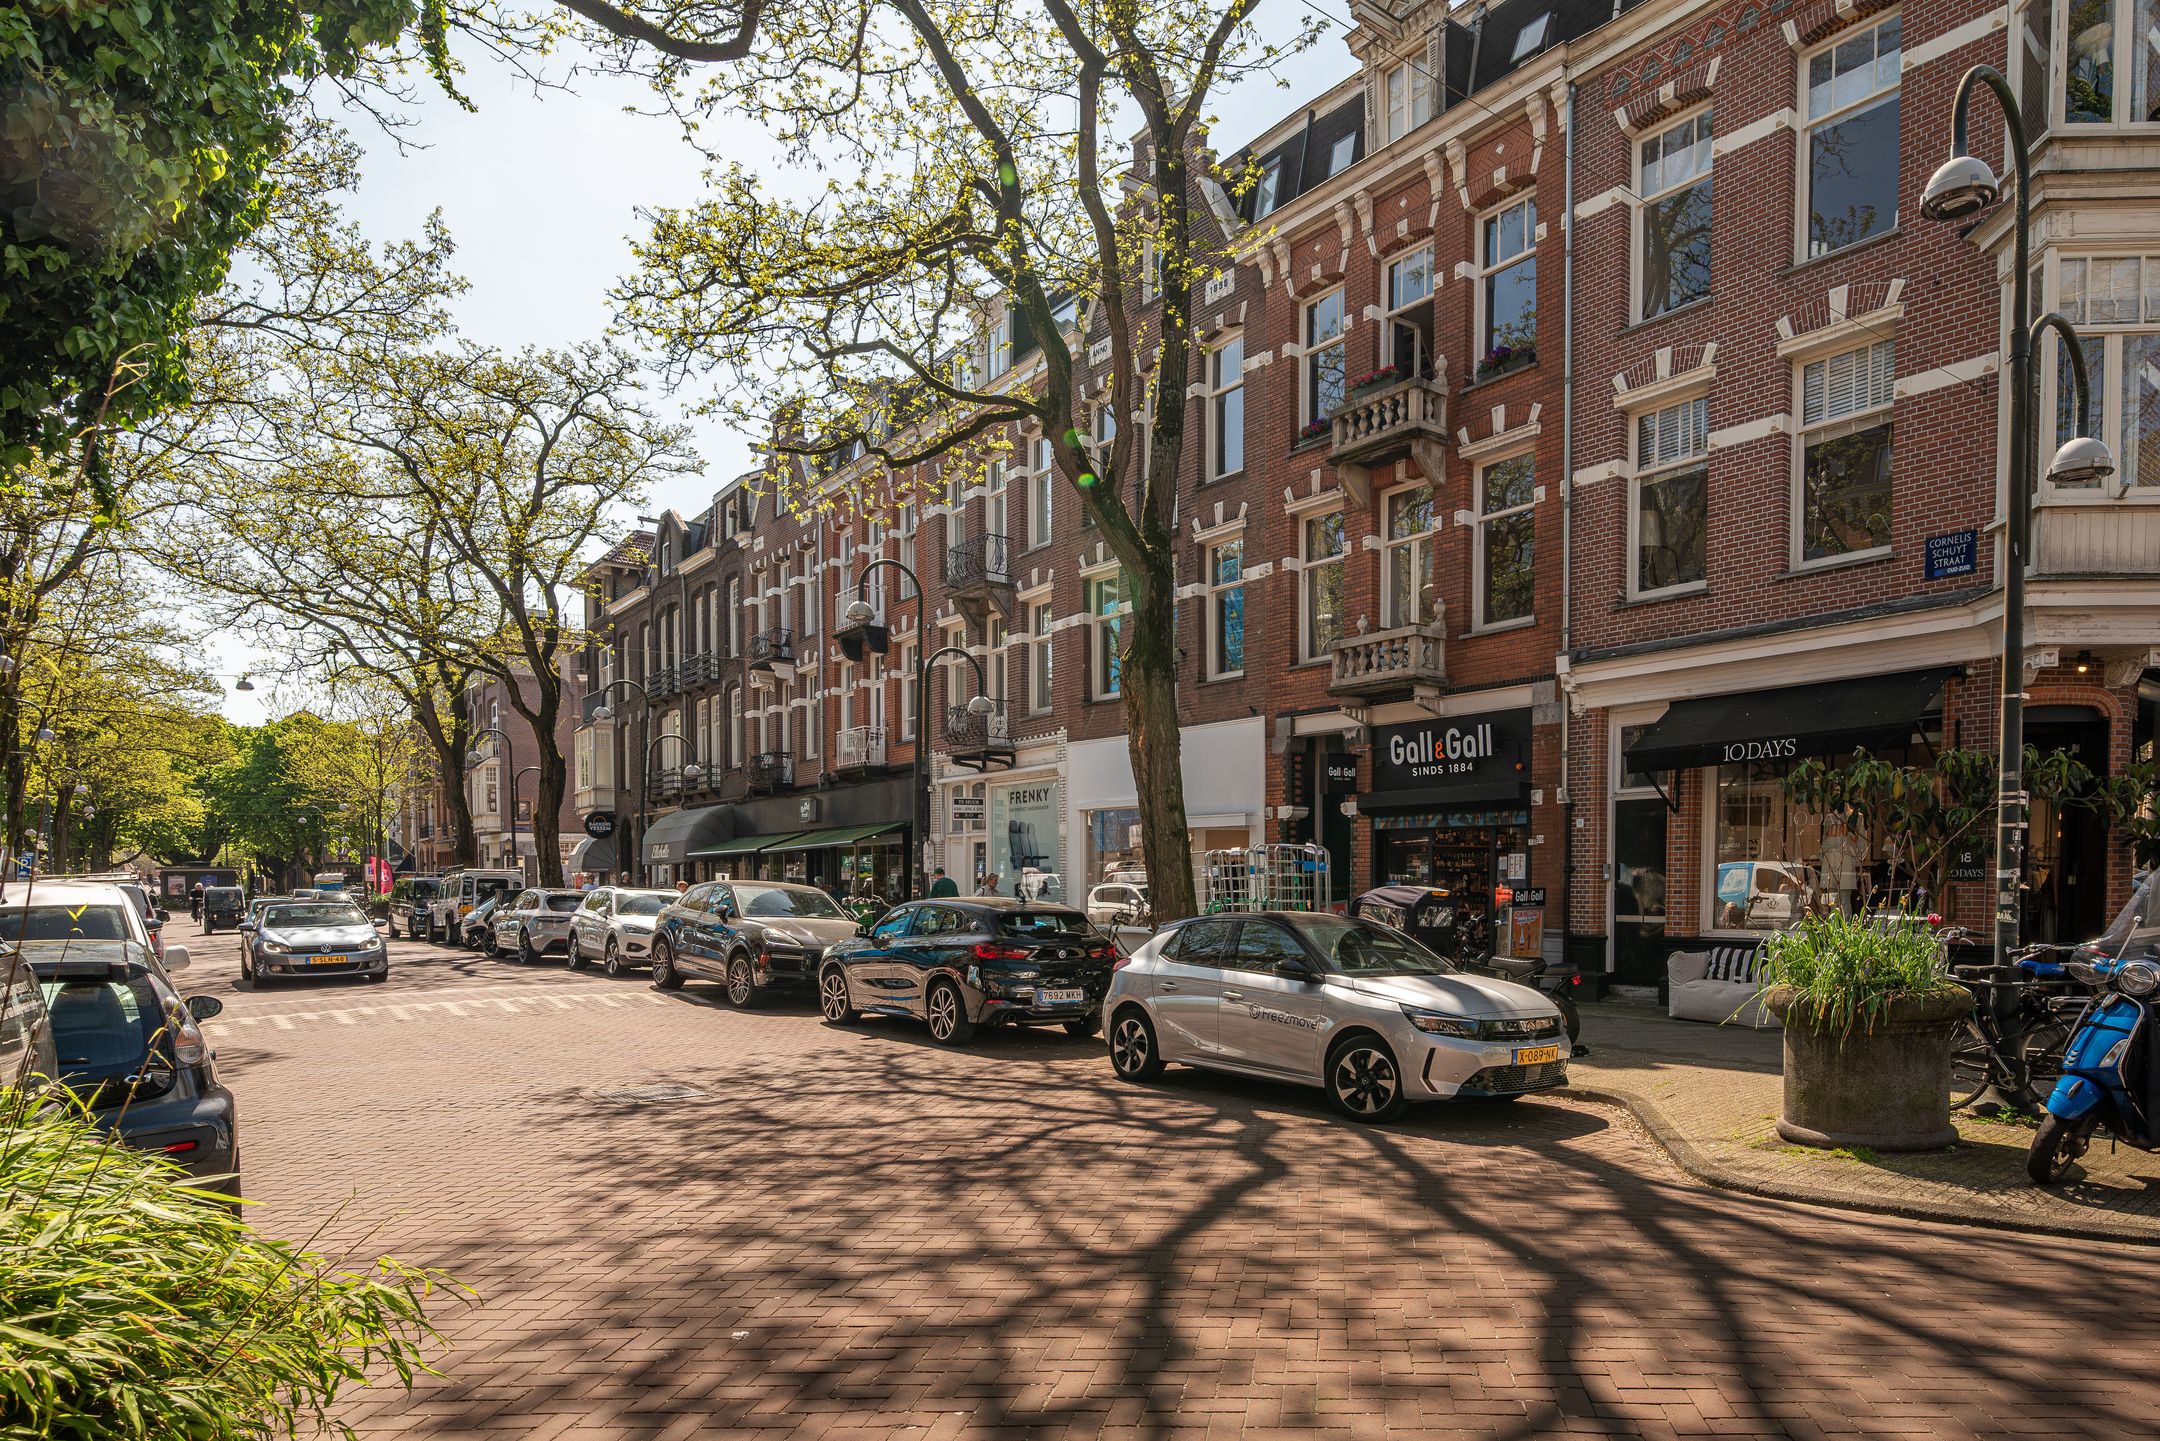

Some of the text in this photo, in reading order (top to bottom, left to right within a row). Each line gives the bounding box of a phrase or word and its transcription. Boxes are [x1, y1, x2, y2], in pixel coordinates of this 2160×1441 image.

[1929, 532, 1972, 549] CORNELIS
[1932, 544, 1967, 559] SCHUYT
[1933, 554, 1966, 569] STRAAT
[1412, 762, 1474, 777] SINDS 1884
[1960, 852, 1972, 863] 18
[1515, 890, 1544, 902] Gall Gall
[1043, 990, 1081, 1000] 7692 MKH
[1261, 1009, 1318, 1030] Free2move
[1519, 1048, 1556, 1063] X-089-NK
